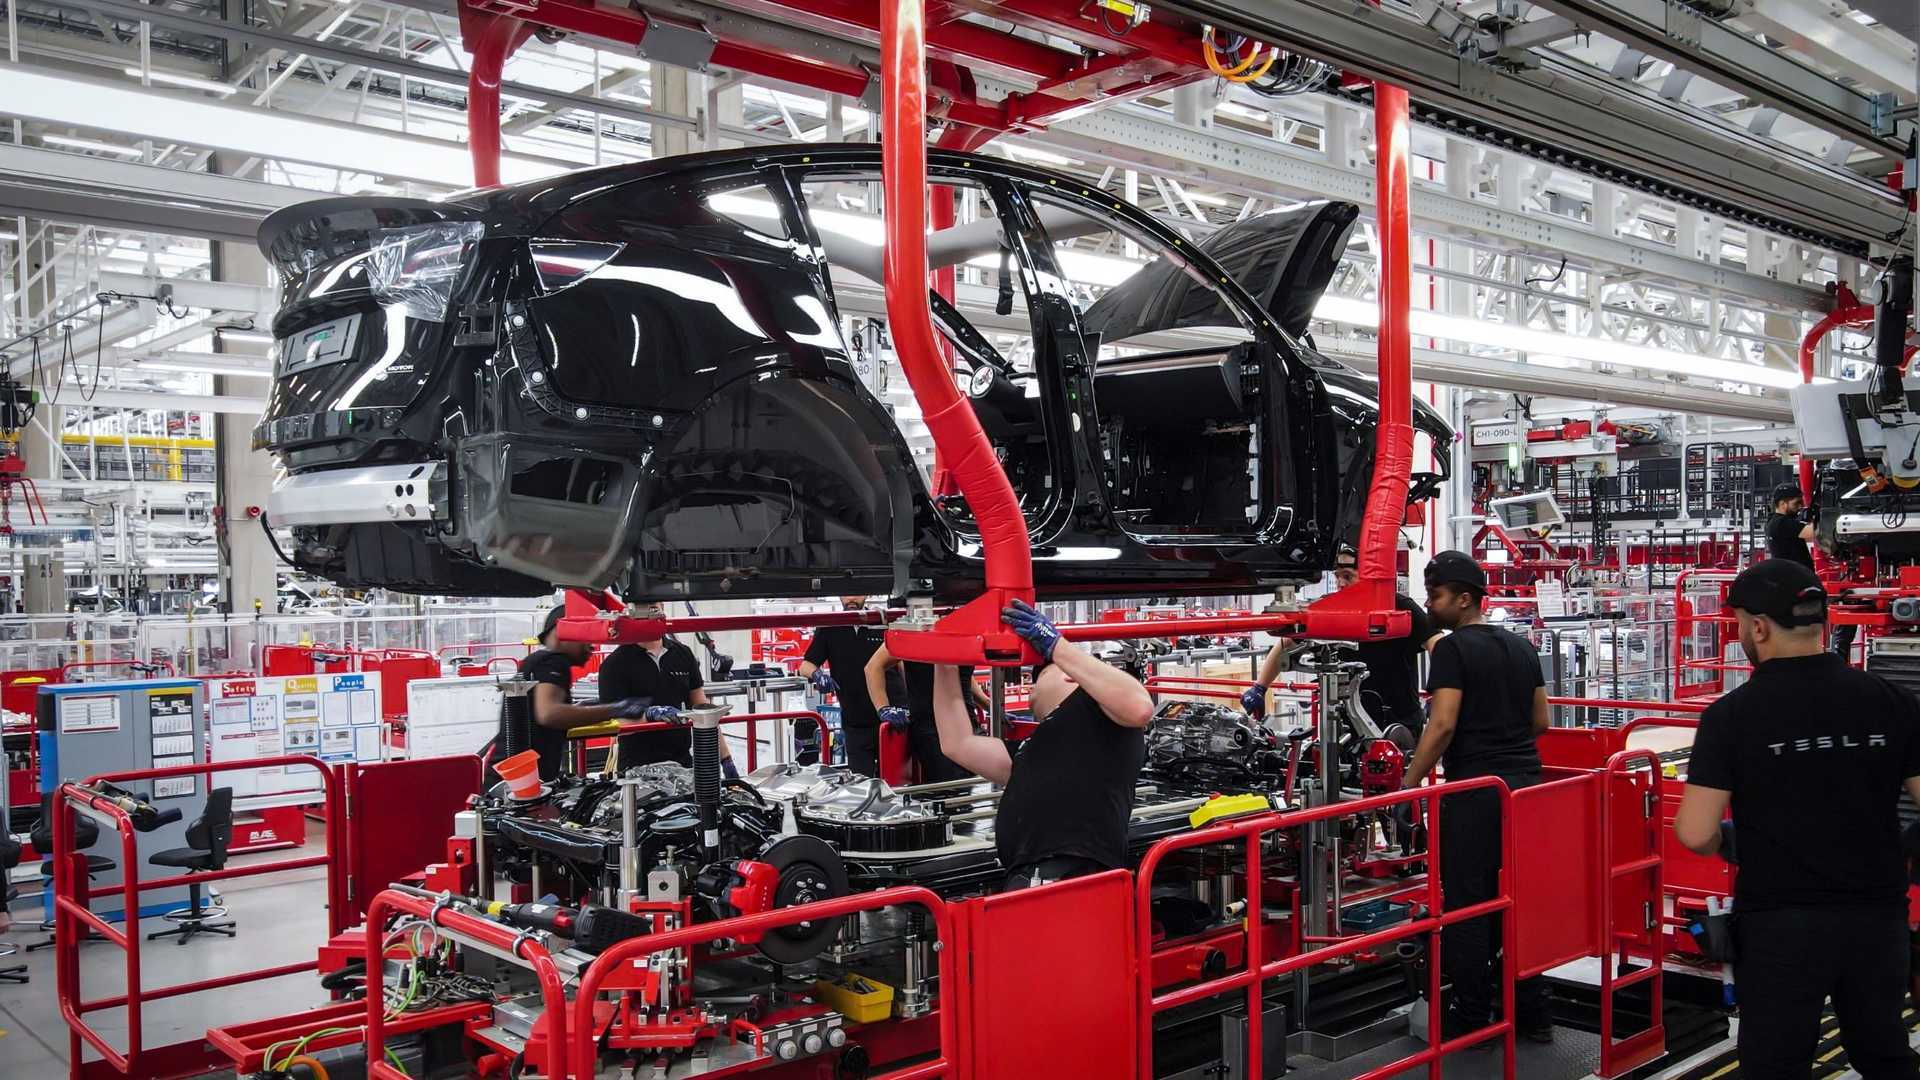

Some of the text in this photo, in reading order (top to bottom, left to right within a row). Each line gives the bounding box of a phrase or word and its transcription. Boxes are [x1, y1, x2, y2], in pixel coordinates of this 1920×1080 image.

[334, 676, 364, 687] People
[223, 682, 256, 693] Safety
[1768, 734, 1885, 756] TESLA
